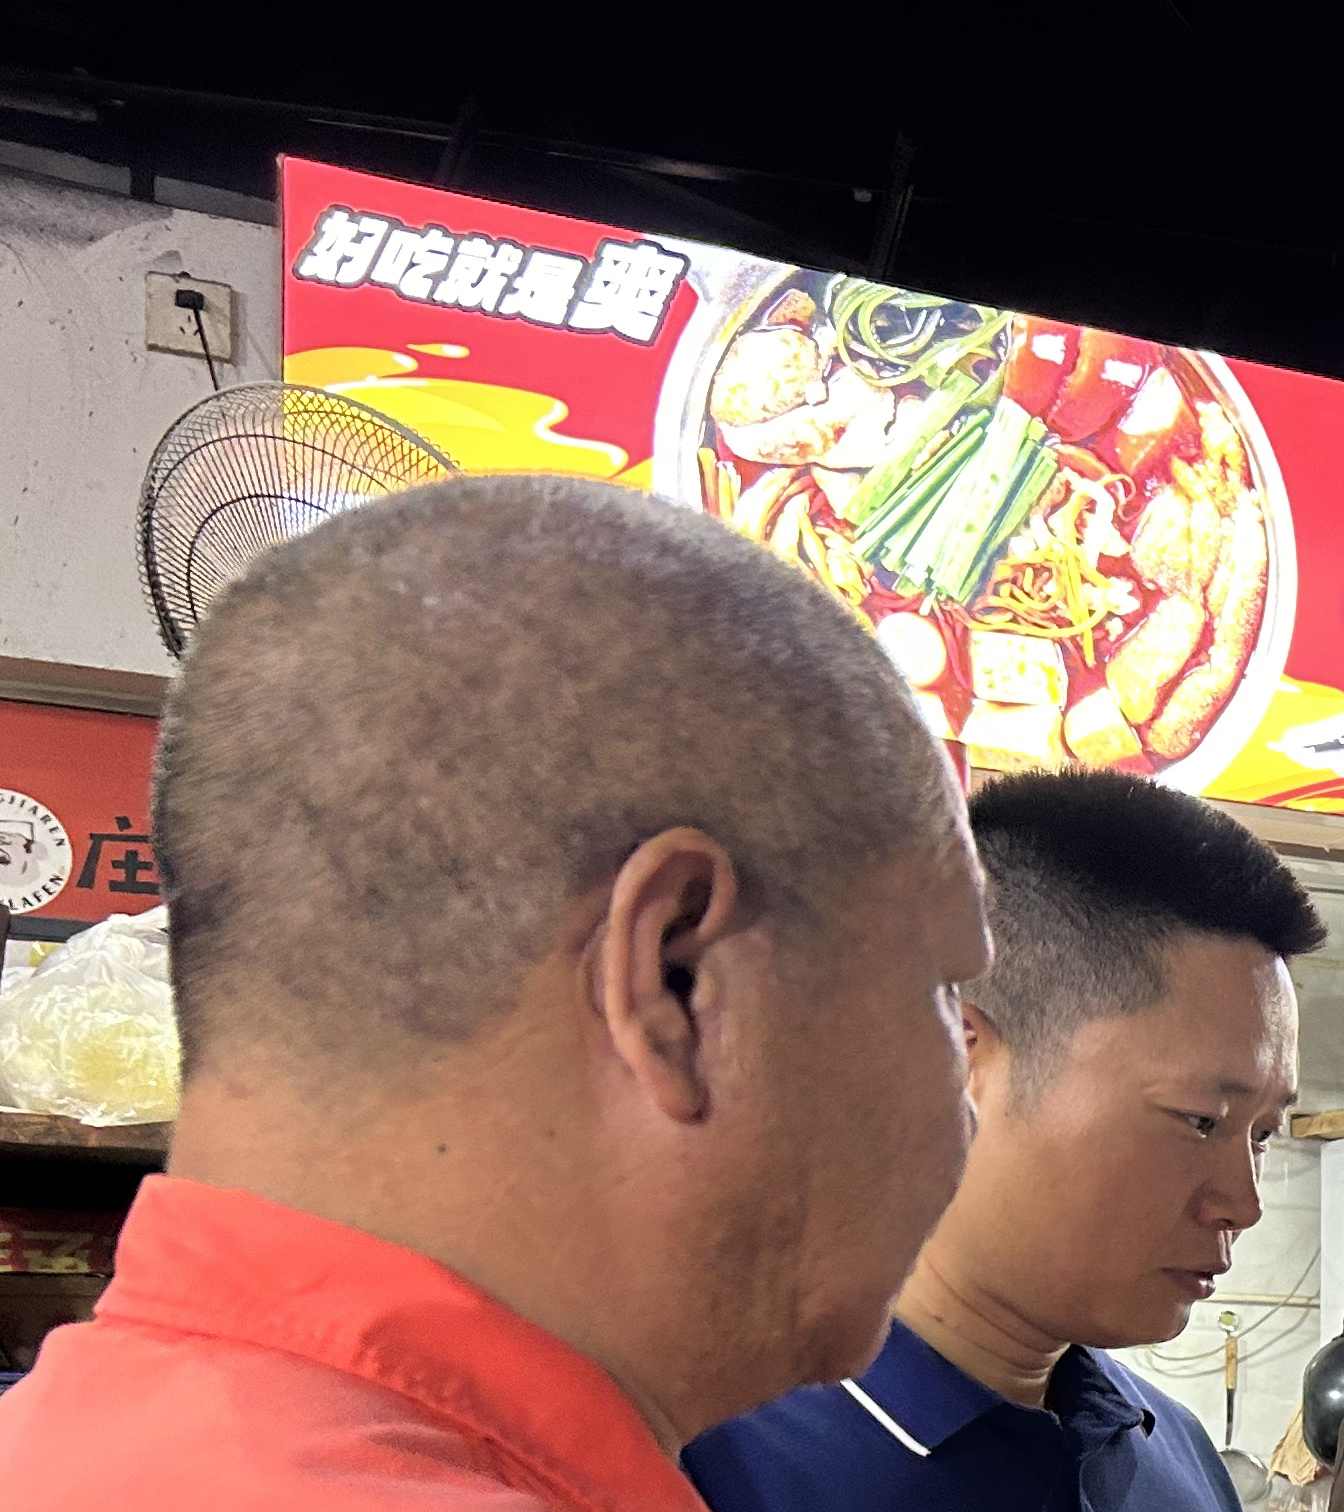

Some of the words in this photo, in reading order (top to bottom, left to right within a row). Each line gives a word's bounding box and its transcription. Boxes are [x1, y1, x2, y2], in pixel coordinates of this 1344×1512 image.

[297, 203, 688, 343] 好吃就是爽
